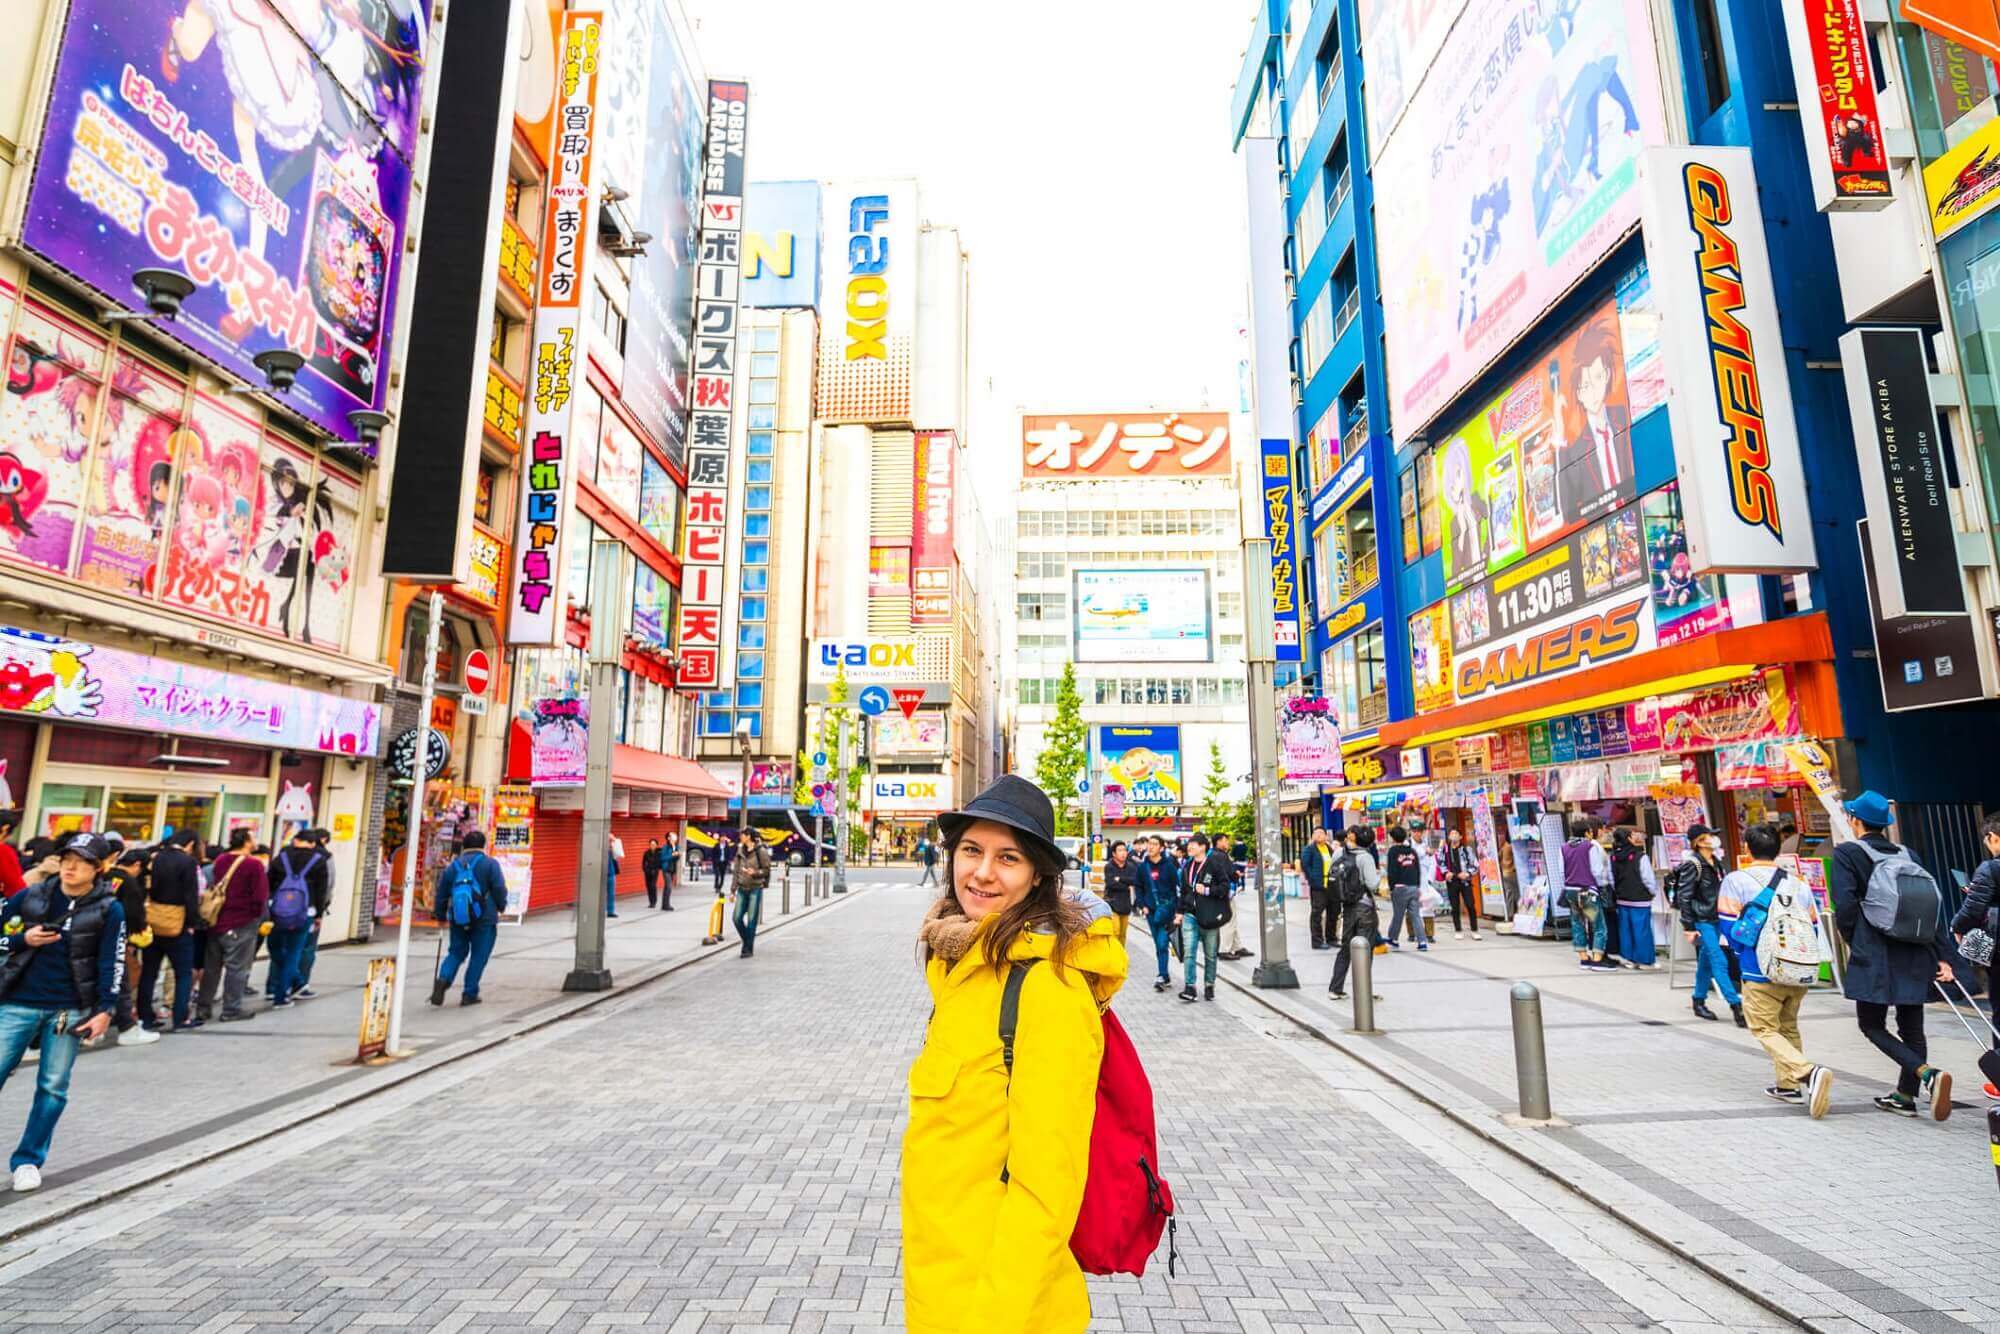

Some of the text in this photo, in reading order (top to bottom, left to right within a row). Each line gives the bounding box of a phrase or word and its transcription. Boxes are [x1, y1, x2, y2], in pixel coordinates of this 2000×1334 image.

[562, 105, 590, 176] 買取り
[706, 84, 729, 193] ARADISE
[726, 84, 746, 158] OBBY
[551, 210, 579, 297] まっくす
[535, 343, 557, 415] 買います
[1683, 163, 1783, 546] GAMERS
[1025, 413, 1228, 471] オノデン
[1879, 377, 1915, 561] ALIENWARE STORE AKIBA
[1918, 430, 1939, 507] Dell Real Site
[209, 632, 238, 649] ESPACE
[1499, 577, 1554, 629] 11.30
[1457, 596, 1650, 701] GAMERS
